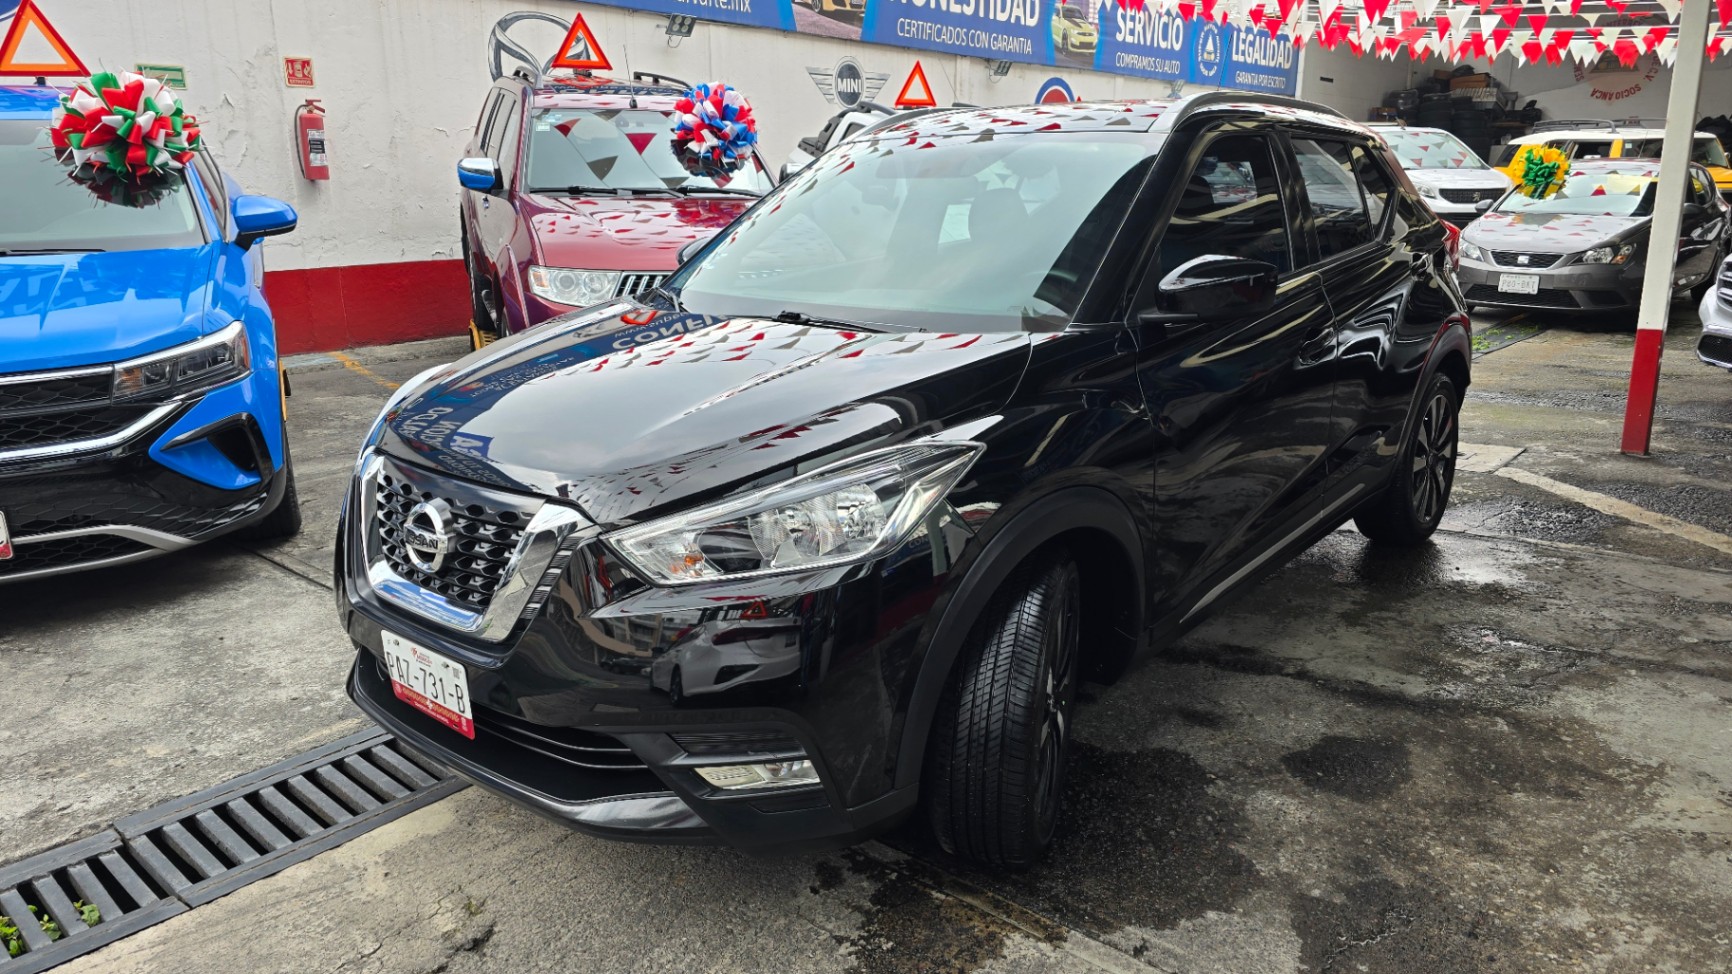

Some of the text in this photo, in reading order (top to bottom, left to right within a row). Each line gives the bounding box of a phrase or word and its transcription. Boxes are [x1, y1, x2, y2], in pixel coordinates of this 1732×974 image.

[676, 0, 752, 13] rte.mx
[889, 0, 1040, 27] TIDAD
[897, 17, 1032, 55] CERTIFICADOS CON GARANTIA
[1116, 6, 1183, 51] SERVICIO
[1232, 30, 1293, 69] LEGALIDAD
[1115, 52, 1180, 75] COMPRAMOS SU AUTO
[837, 77, 862, 92] MINI
[1615, 83, 1642, 100] SOCIO
[406, 529, 439, 550] SSAN
[386, 651, 465, 714] PAZ-731-B
